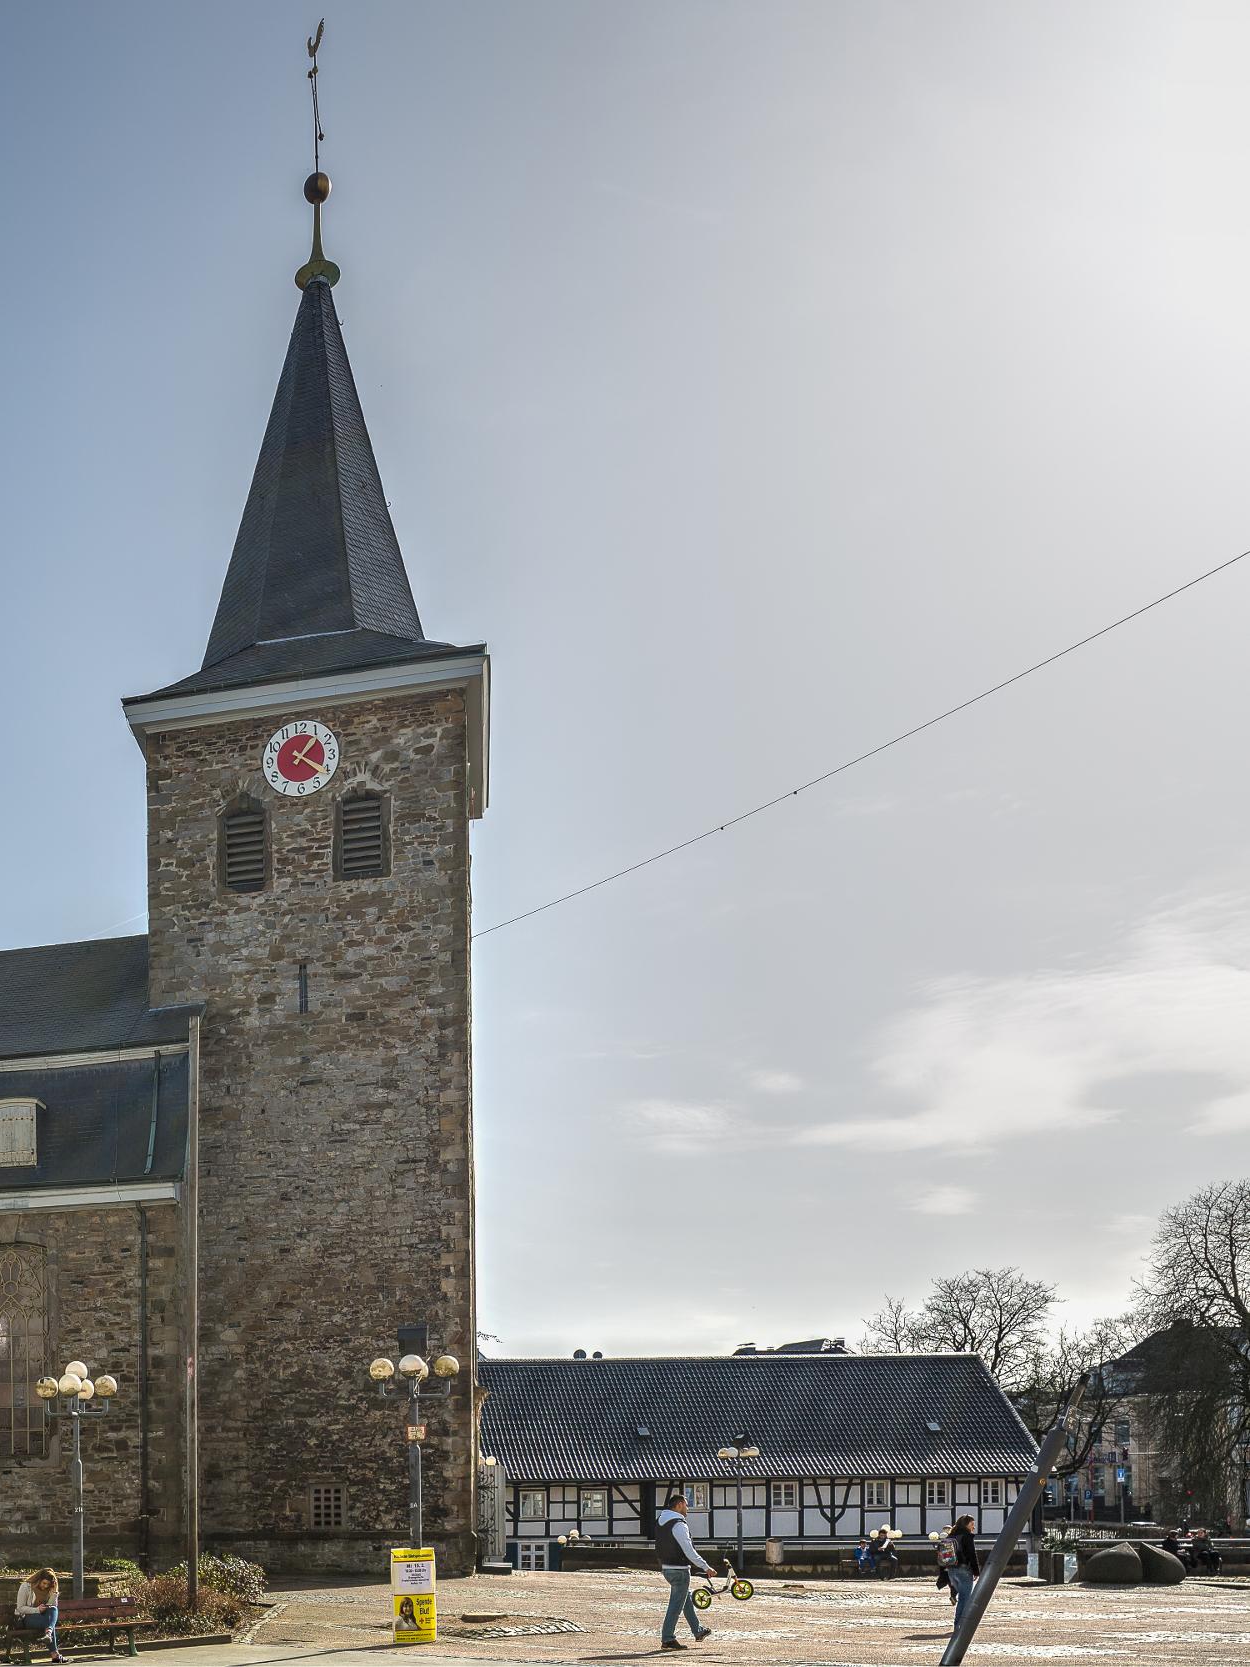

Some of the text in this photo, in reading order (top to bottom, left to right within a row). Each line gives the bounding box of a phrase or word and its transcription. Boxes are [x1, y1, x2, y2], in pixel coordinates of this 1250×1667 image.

[281, 728, 289, 739] 11
[294, 722, 307, 734] 12
[314, 725, 318, 735] 1
[324, 733, 332, 745] 2
[270, 741, 280, 753] 10
[328, 749, 336, 760] 3
[266, 757, 274, 768] 9
[271, 771, 279, 783] 8
[282, 781, 289, 793] 7
[297, 783, 305, 794] 6
[313, 777, 321, 789] 5
[416, 1598, 432, 1607] Spende
